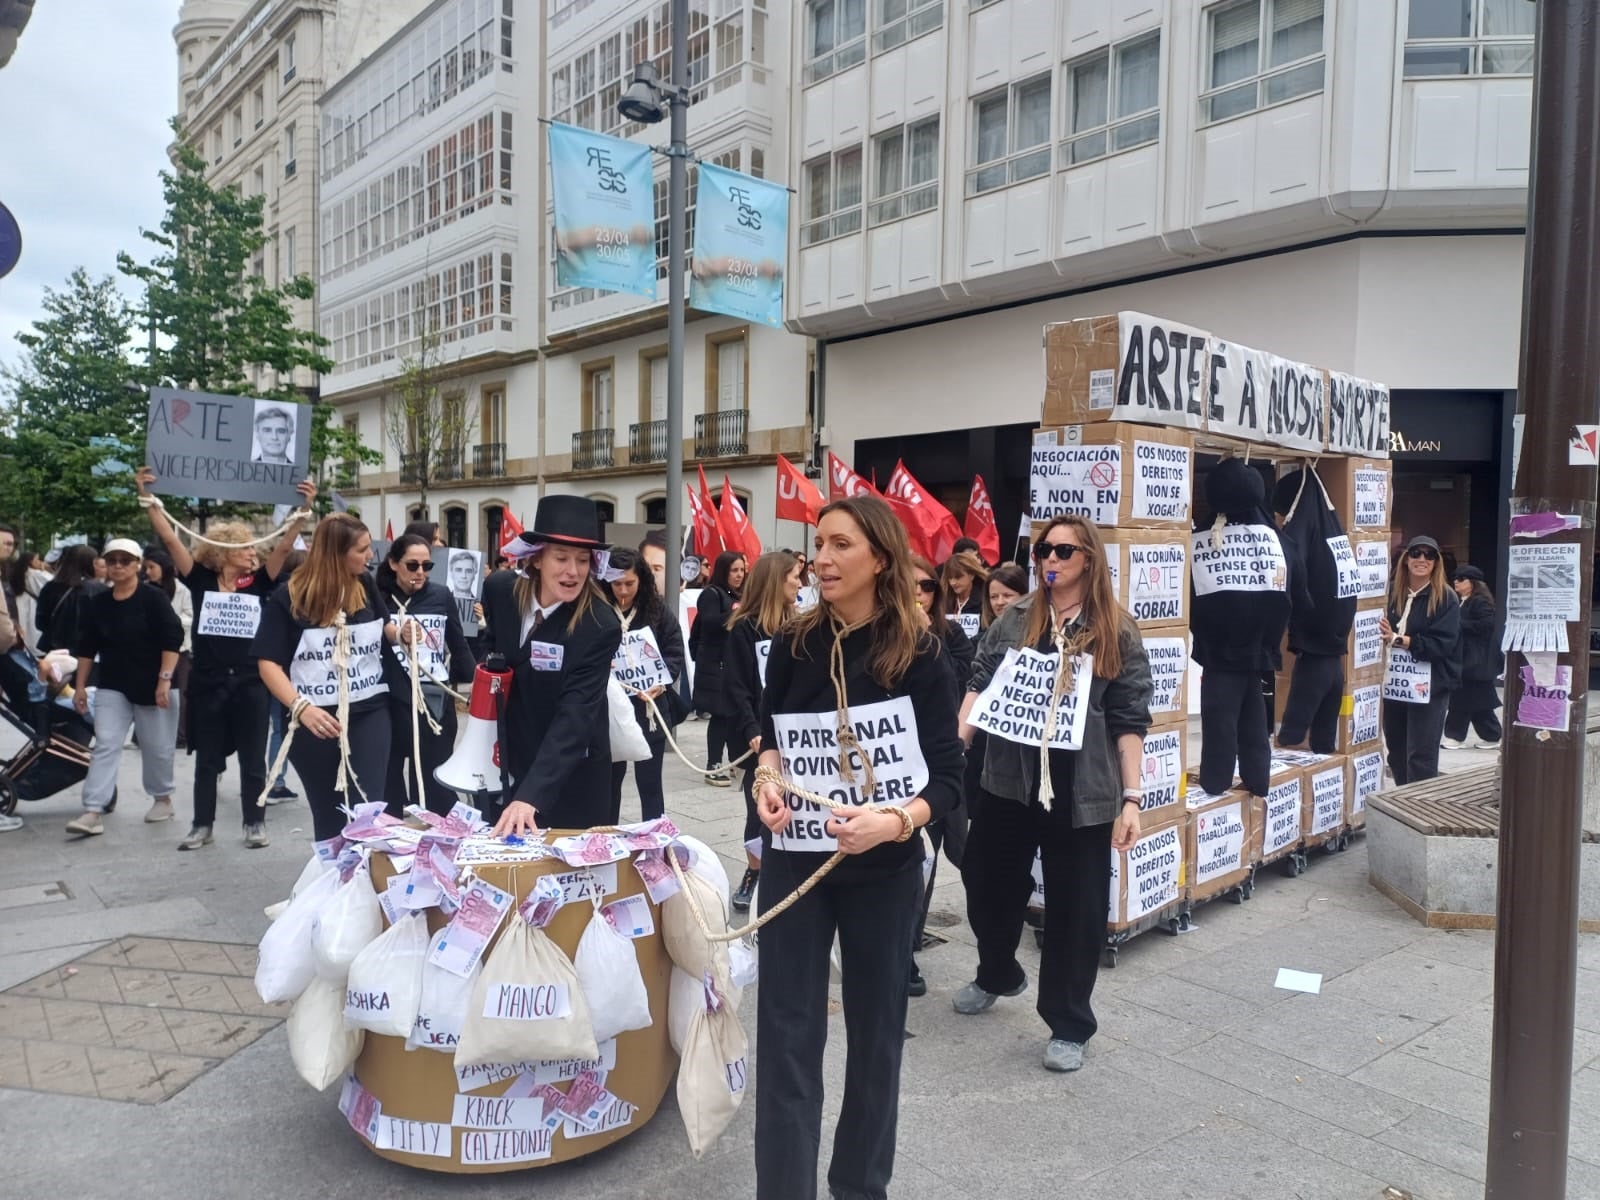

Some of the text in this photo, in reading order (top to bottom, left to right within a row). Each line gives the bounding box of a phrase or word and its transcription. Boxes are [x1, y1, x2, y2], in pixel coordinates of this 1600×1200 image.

[595, 228, 629, 245] 23/04
[728, 259, 758, 278] 23/04
[1117, 324, 1206, 416] ARTE
[1238, 360, 1257, 429] A
[1267, 365, 1324, 443] NOSA
[1328, 377, 1388, 451] MORTE
[150, 397, 234, 442] ARTE
[1137, 445, 1187, 463] COS NOSOS
[1407, 440, 1441, 452] MAN
[1032, 447, 1120, 463] NEGOCIACIÓN
[1142, 465, 1183, 481] DEREITOS
[1031, 490, 1118, 504] E NON EN
[1146, 484, 1180, 498] NON SE
[1147, 503, 1176, 517] XOGA!
[1195, 540, 1204, 550] A
[1520, 546, 1575, 555] OFRECEN
[1132, 552, 1144, 564] NA
[1206, 560, 1276, 574] TENSE QUE
[1136, 566, 1178, 591] ARTE
[1216, 574, 1267, 586] SENTAR
[219, 610, 246, 619] NOSO
[1134, 600, 1179, 620] SOBRA!
[207, 617, 253, 628] CONVENIO
[615, 665, 646, 681] NON
[1013, 671, 1042, 689] HAI
[1161, 678, 1177, 691] QUE
[1523, 685, 1567, 700] ARZO
[989, 700, 1000, 712] O
[1139, 786, 1176, 811] OBRA!
[1278, 781, 1298, 799] NOSOS
[1269, 798, 1296, 819] DEREITOS
[1212, 811, 1228, 827] AQUÍ
[1286, 814, 1294, 826] SE
[1130, 830, 1176, 861] COS NOSOS
[1212, 841, 1228, 858] AQUÍ
[1135, 850, 1175, 878] DEREITOS
[1199, 853, 1239, 874] NEGOCIAMOS
[1139, 870, 1171, 895] NON SE
[496, 984, 557, 1019] MANGO
[465, 1097, 515, 1126] KRACK
[390, 1118, 440, 1154] FIFTY
[465, 1128, 551, 1161] CALZEDONIA
